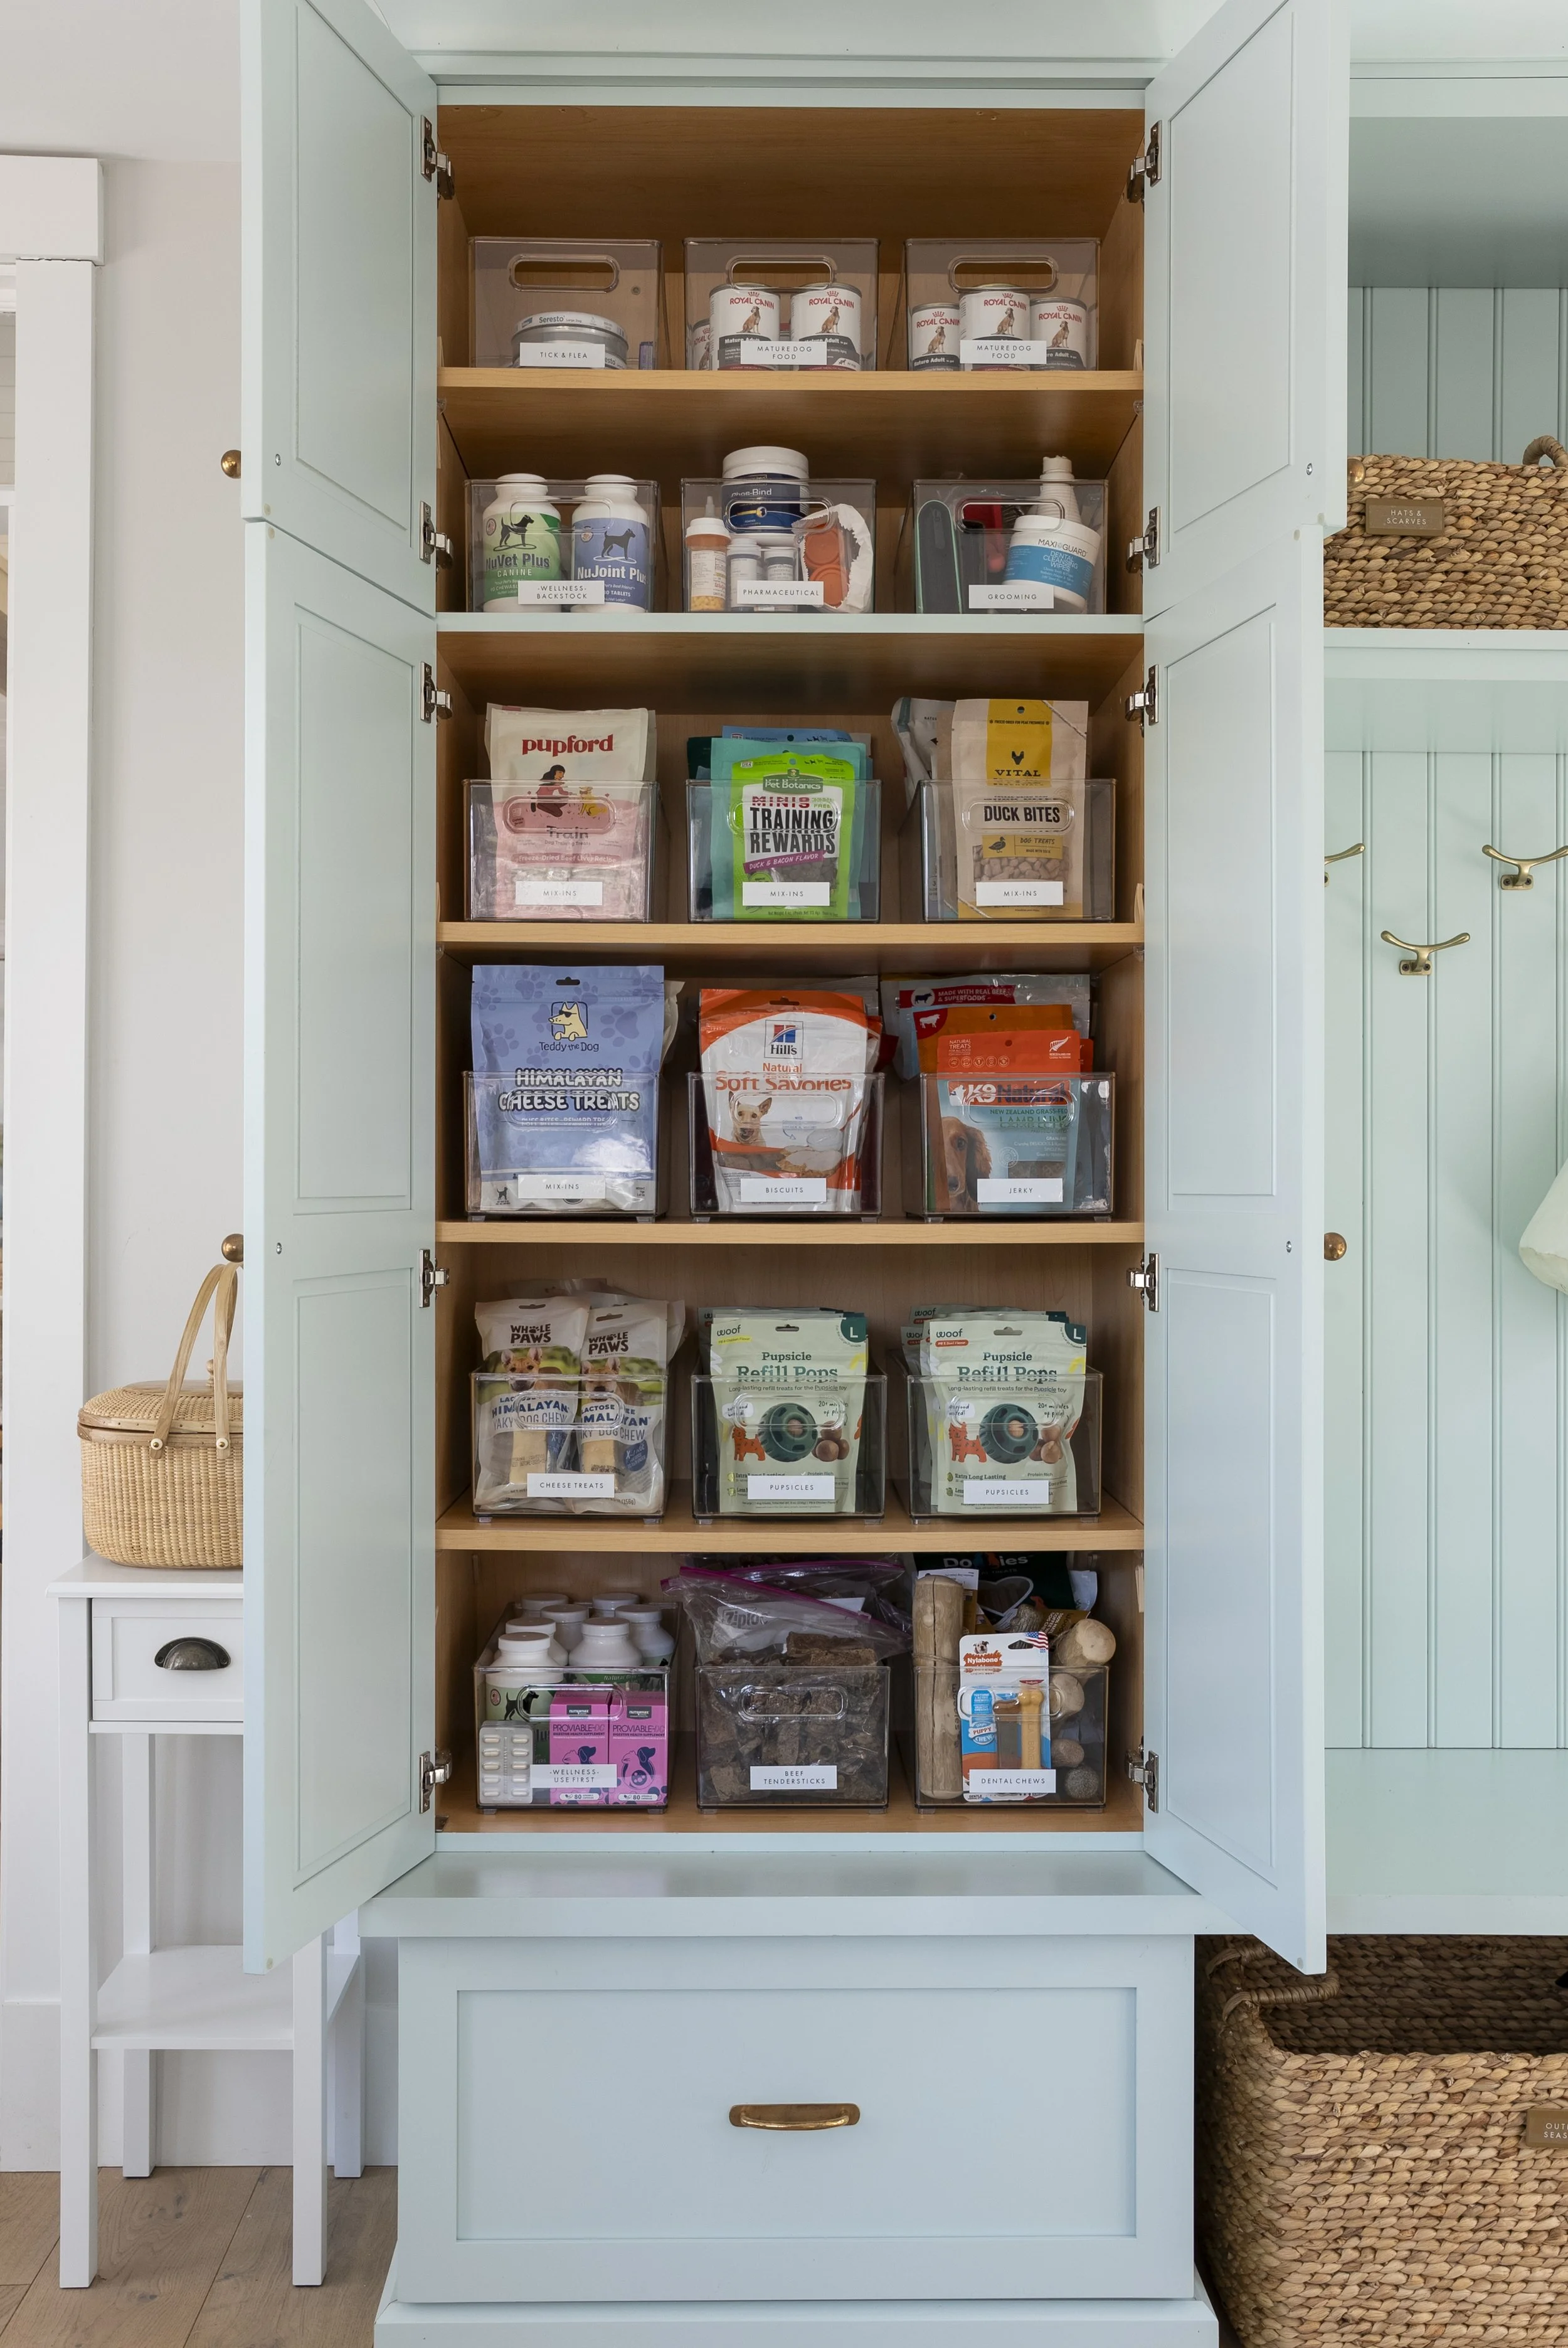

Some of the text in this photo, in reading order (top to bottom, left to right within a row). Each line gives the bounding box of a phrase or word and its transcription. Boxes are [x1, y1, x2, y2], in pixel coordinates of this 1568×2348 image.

[755, 297, 774, 309] CANIN
[834, 298, 854, 309] CANIN
[1009, 300, 1026, 311] CANIN
[917, 319, 937, 327] ROYAL
[1064, 313, 1082, 323] CANIN
[1038, 539, 1086, 557] MAXI GUARD
[486, 553, 549, 571] NuVet Plus
[1043, 555, 1078, 569] CLEANSING
[1051, 551, 1074, 562] DENTAL
[1051, 562, 1070, 571] WIPES
[497, 569, 532, 577] CANINE
[578, 566, 647, 585] NuJoint Plus
[522, 734, 613, 757] pupford
[765, 779, 820, 789] Pet Botanics
[753, 796, 810, 808] MINIS
[750, 807, 835, 833] TRAINING
[984, 805, 1060, 823] DUCK BITES
[750, 832, 835, 854] REWARDS
[539, 1042, 567, 1052] Teddy
[581, 1043, 599, 1052] Dog
[770, 1044, 797, 1054] Hill's
[763, 1063, 802, 1073] Natural
[516, 1068, 623, 1086] HIMALAYAN
[716, 1075, 851, 1092] Soft Savories
[499, 1090, 640, 1112] CHEESE TREATS
[914, 1308, 936, 1316] woof
[717, 1325, 741, 1336] woof
[850, 1327, 858, 1338] L
[936, 1329, 963, 1337] woof
[1074, 1328, 1081, 1340] L
[511, 1332, 551, 1344] PAWS
[588, 1340, 628, 1355] PAWS
[761, 1352, 812, 1362] Pupsicle
[983, 1352, 1032, 1363] Pupsicle
[736, 1365, 838, 1383] Refill Pops
[957, 1366, 1057, 1384] Refill Pops
[494, 1413, 567, 1430] YAKY CHEW
[620, 1427, 645, 1440] CHEW
